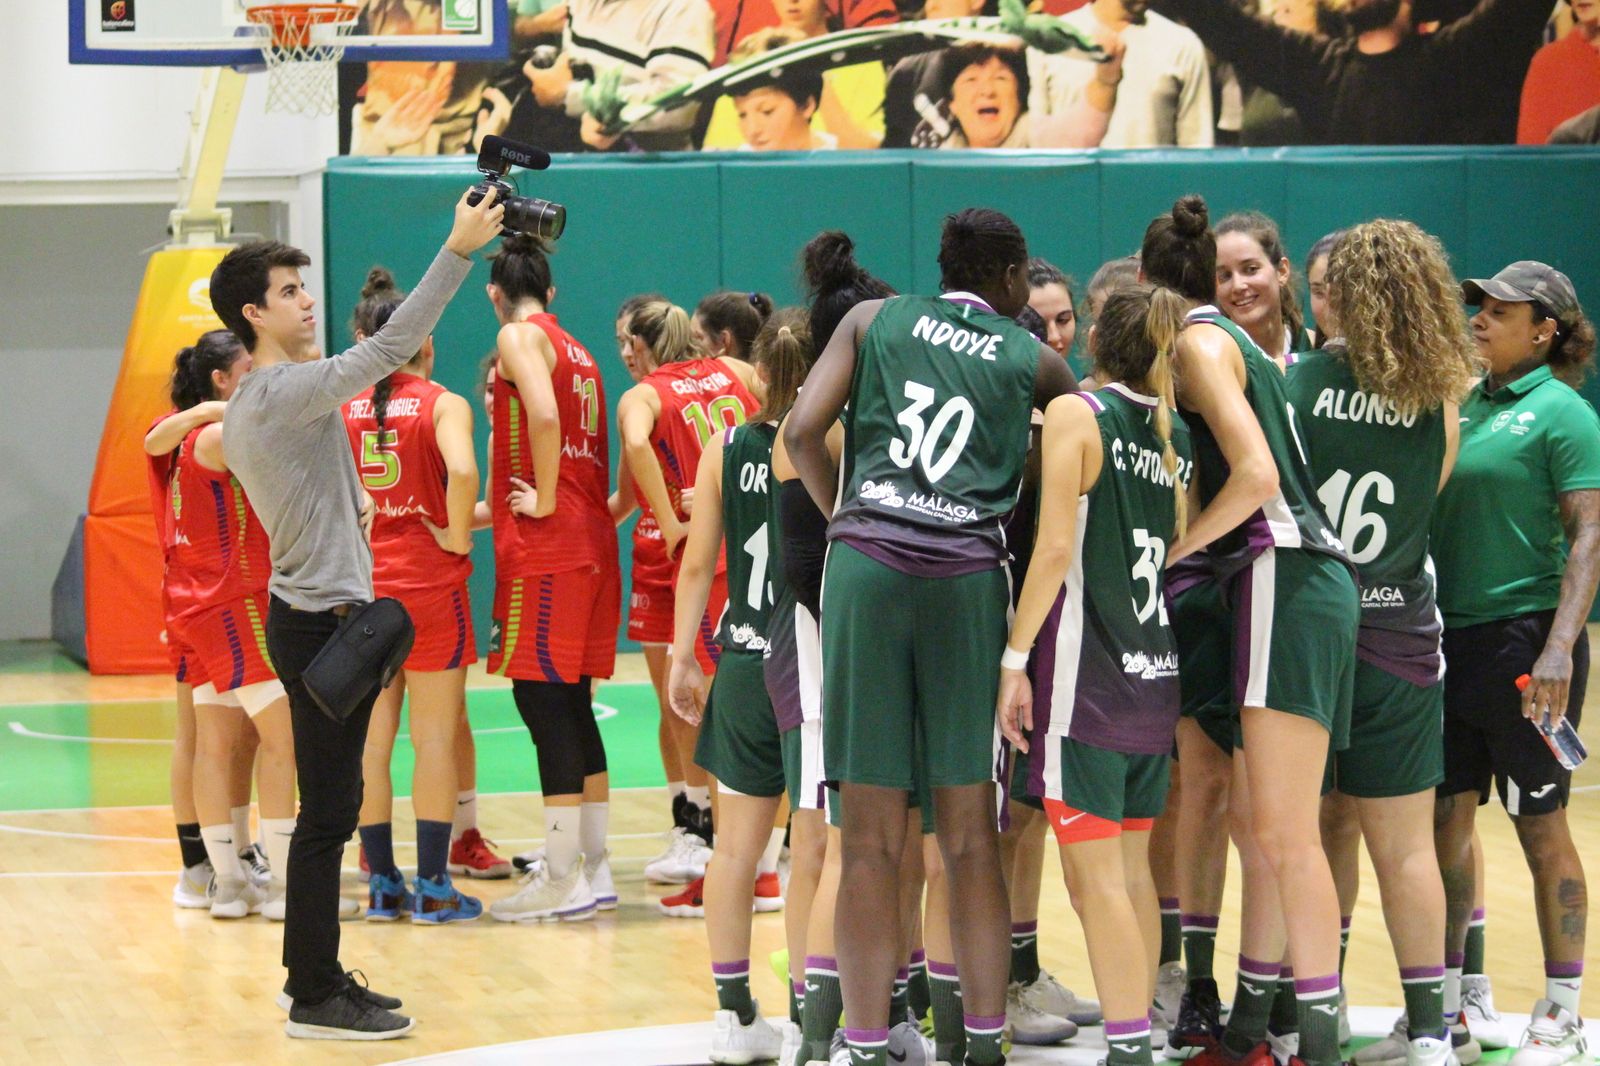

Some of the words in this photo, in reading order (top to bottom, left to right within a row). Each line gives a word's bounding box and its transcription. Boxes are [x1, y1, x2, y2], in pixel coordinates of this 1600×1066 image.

[501, 147, 531, 165] RØDE
[912, 315, 1003, 361] NDOYE
[889, 380, 975, 484] 30
[361, 429, 402, 490] 5
[906, 492, 979, 521] MÁLAGA
[1317, 469, 1395, 564] 16
[1360, 584, 1405, 602] LAGA
